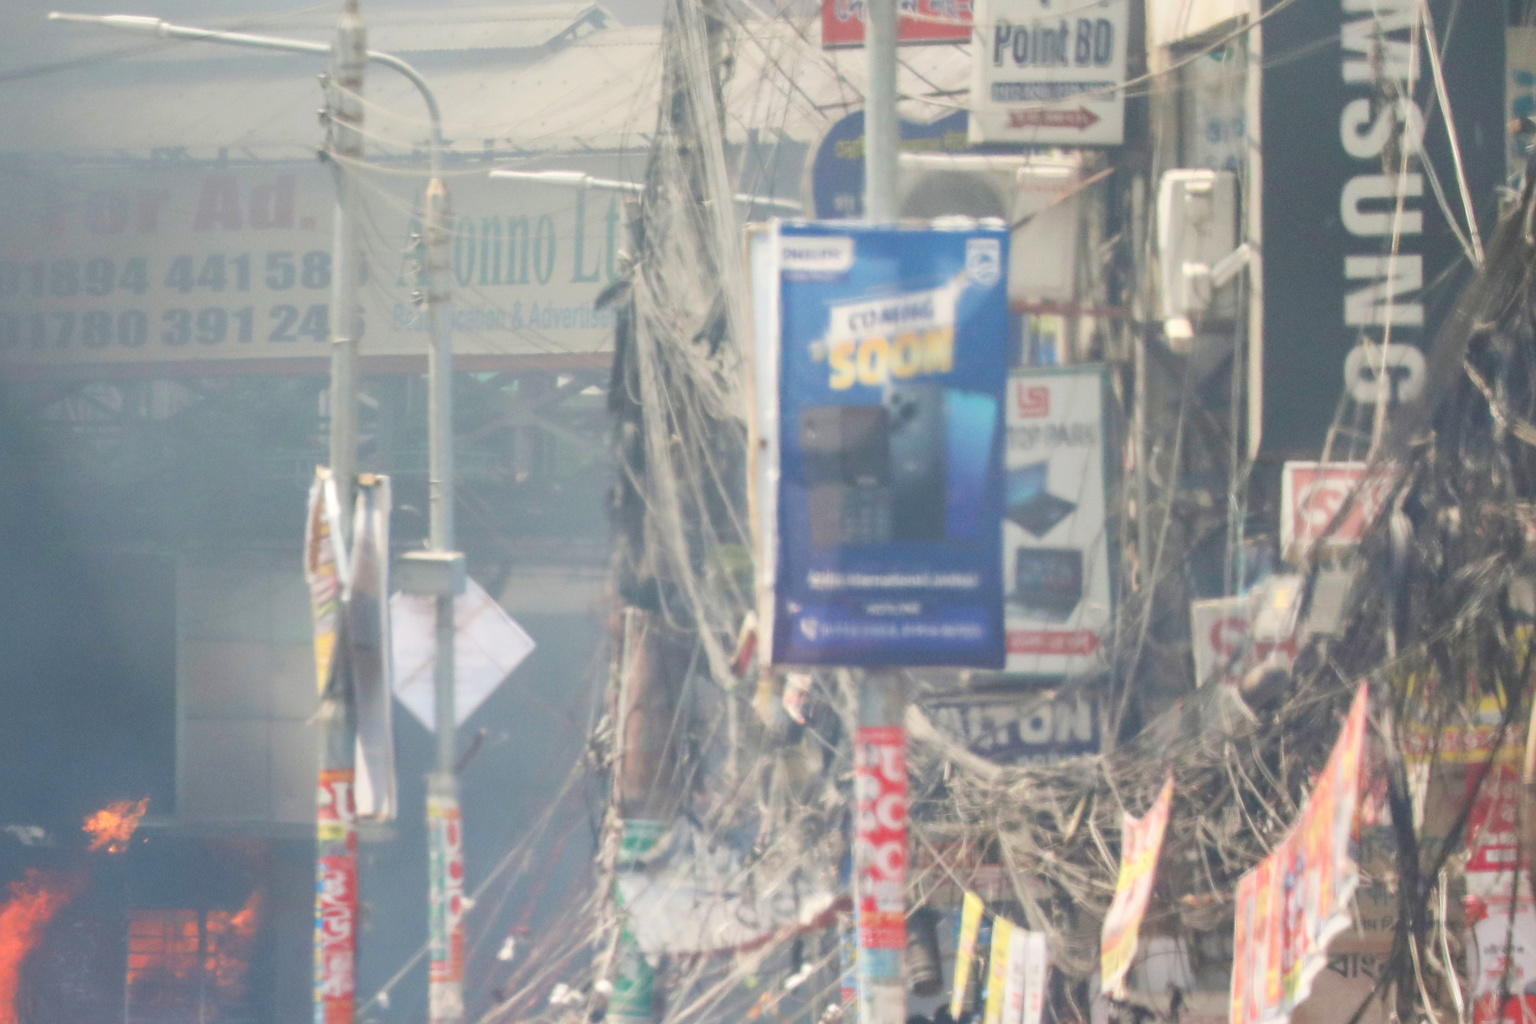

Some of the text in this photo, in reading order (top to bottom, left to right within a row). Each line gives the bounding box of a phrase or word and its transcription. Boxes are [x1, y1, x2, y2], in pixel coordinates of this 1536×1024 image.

[1075, 17, 1113, 67] BD
[192, 172, 317, 231] Ad.
[828, 326, 954, 391] SOON
